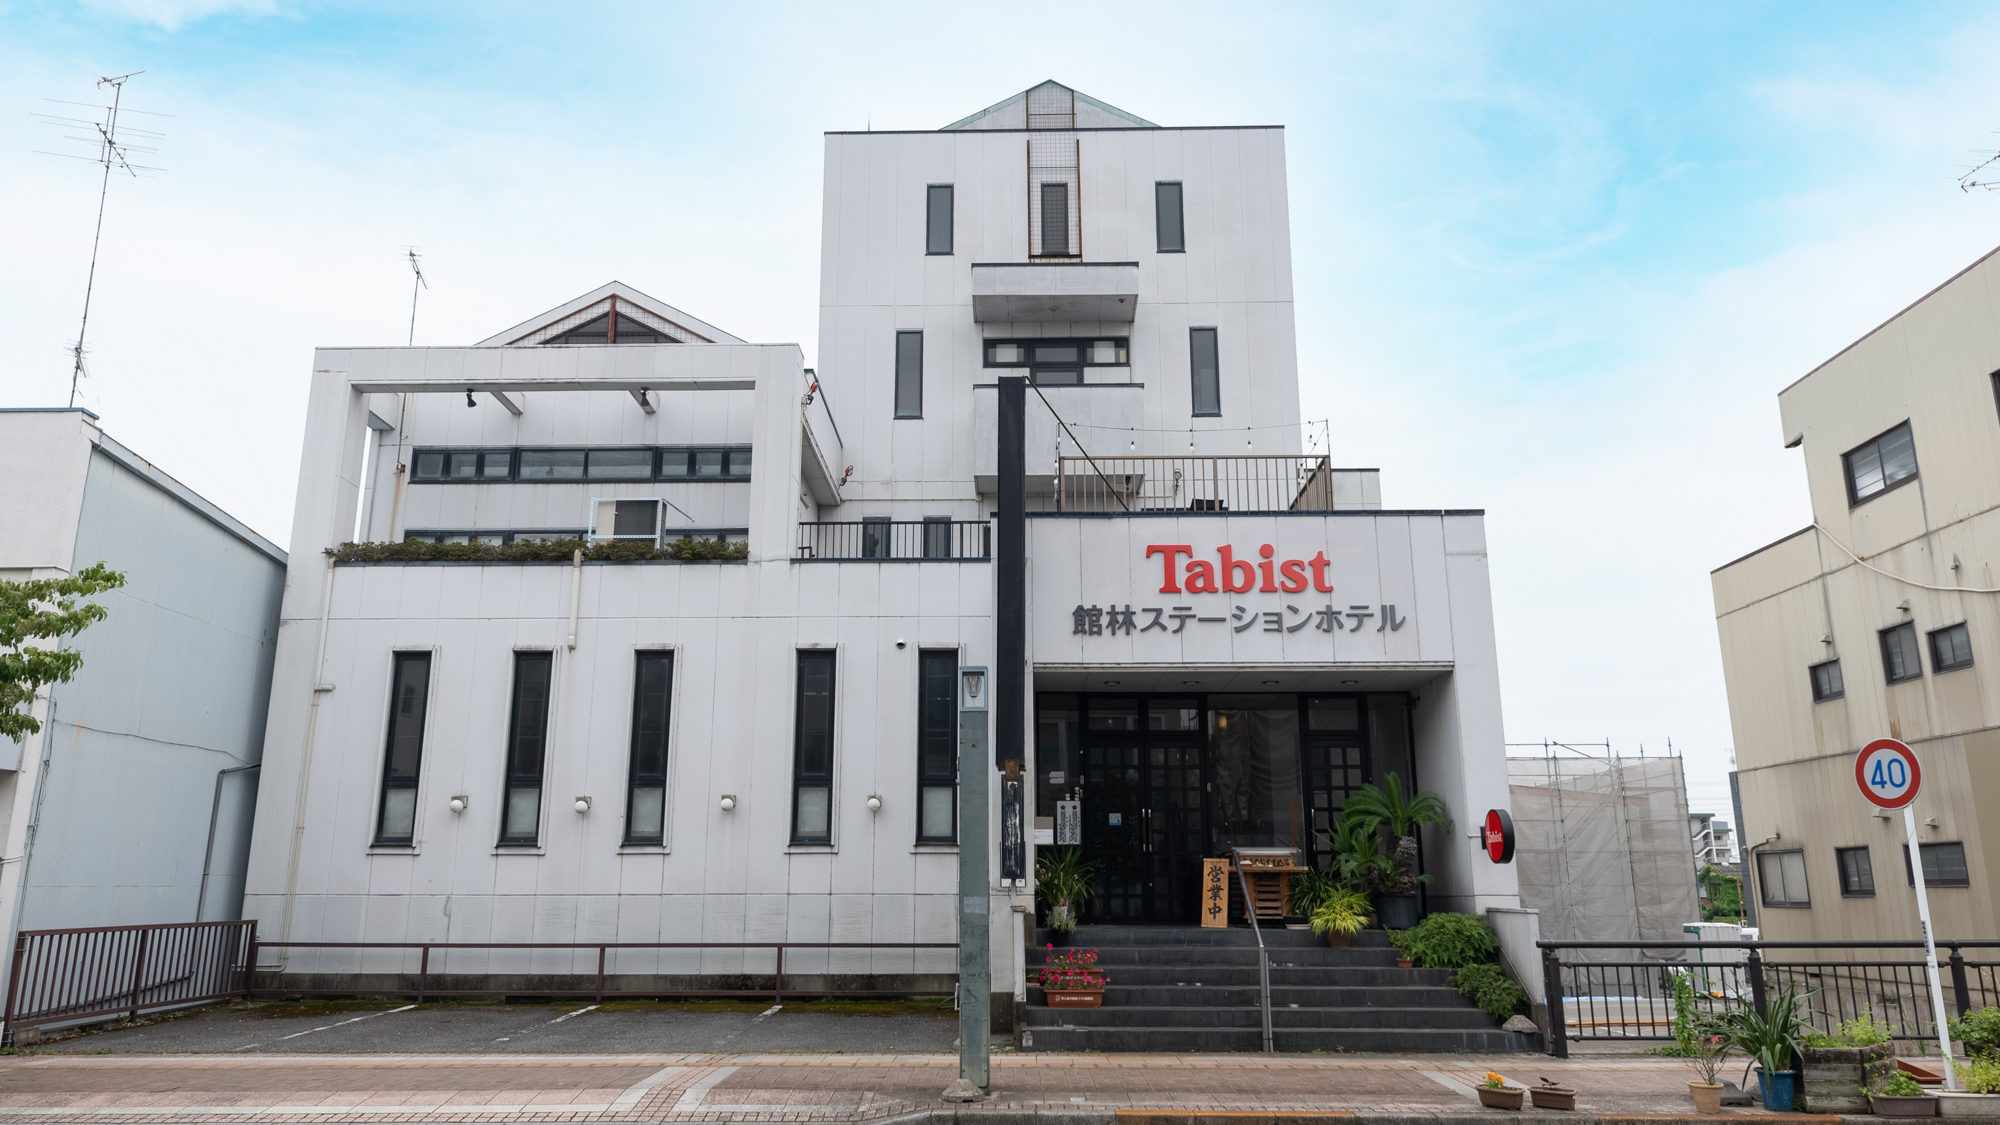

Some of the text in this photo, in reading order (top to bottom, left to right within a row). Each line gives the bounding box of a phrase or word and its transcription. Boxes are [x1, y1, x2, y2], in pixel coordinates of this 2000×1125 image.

[1146, 543, 1334, 594] Tabist
[1072, 604, 1406, 637] 館林ステーションホテル
[1871, 758, 1906, 789] 40
[1486, 830, 1503, 843] Tabist
[1207, 865, 1224, 920] 営業中
